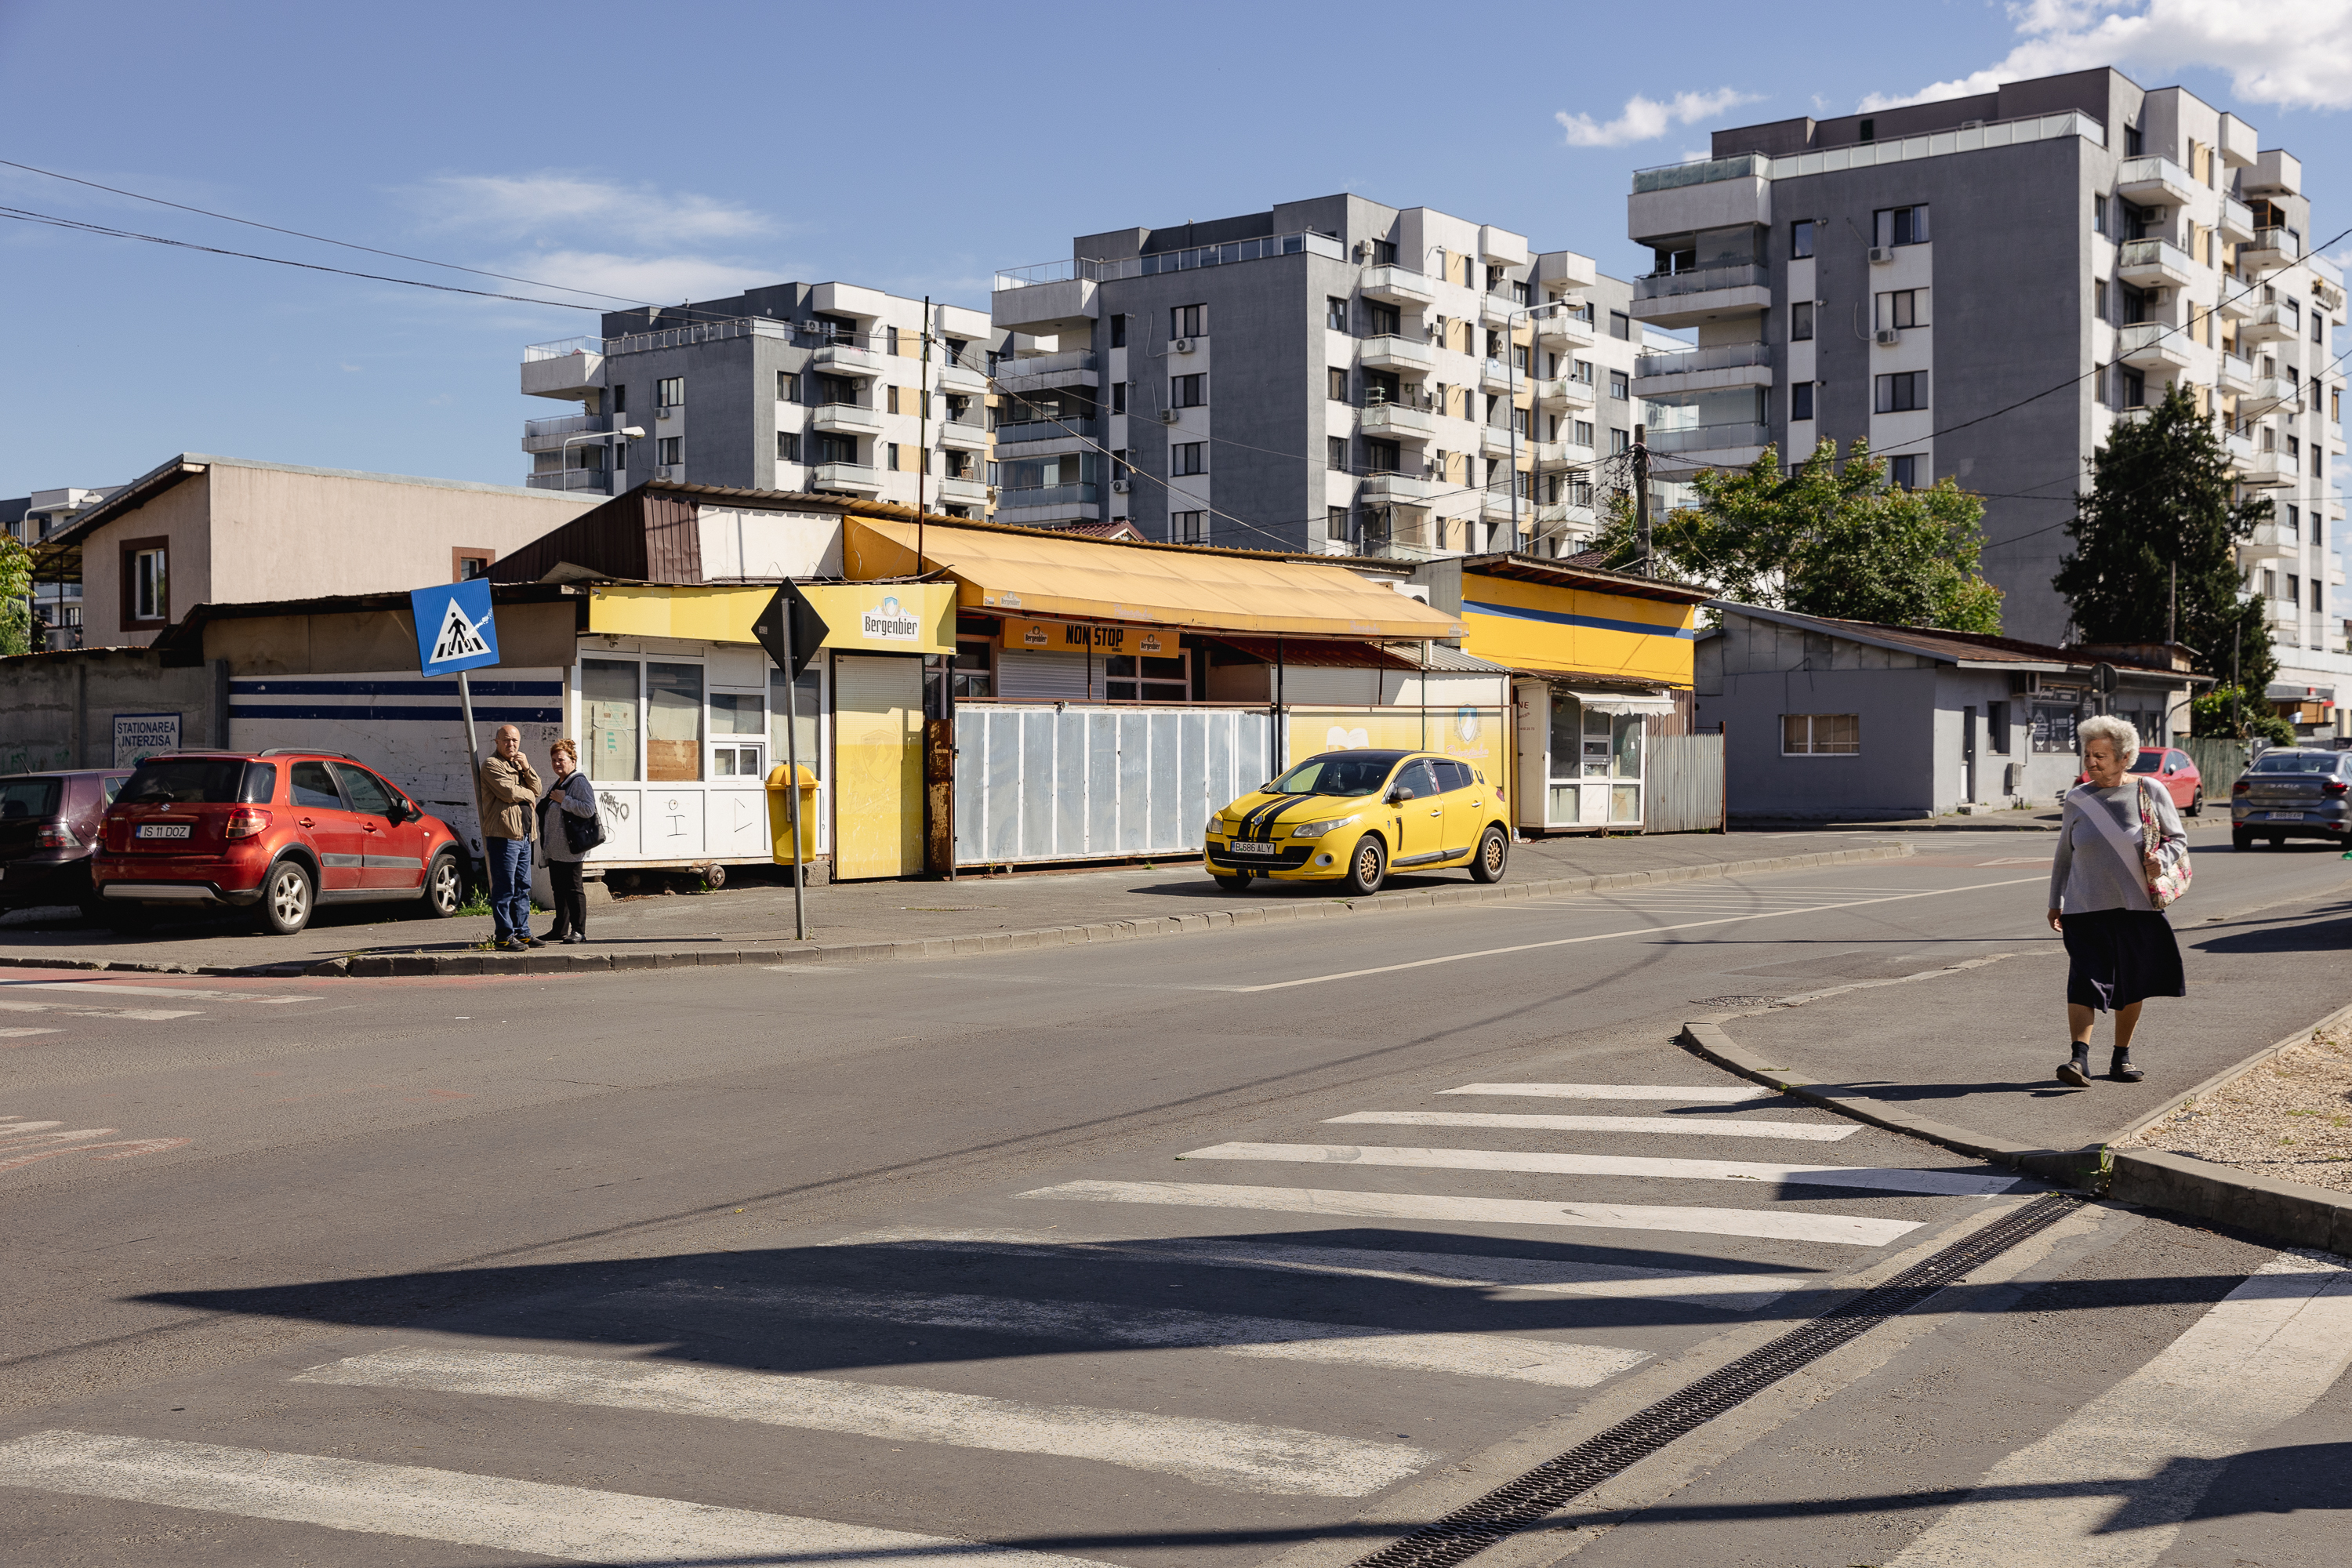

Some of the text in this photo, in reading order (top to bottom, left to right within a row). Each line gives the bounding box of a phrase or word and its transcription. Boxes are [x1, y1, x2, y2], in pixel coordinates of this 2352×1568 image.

[865, 616, 917, 636] Bergenbier
[1025, 633, 1047, 643] Bergenbier
[1066, 625, 1123, 647] NON STOP
[1141, 642, 1160, 651] Bergenbier
[117, 721, 176, 734] STATIONAREA
[122, 735, 172, 747] INTERZISA
[143, 826, 187, 837] IS 11 DOZ
[1243, 843, 1255, 851] 686
[1257, 844, 1271, 852] ALY
